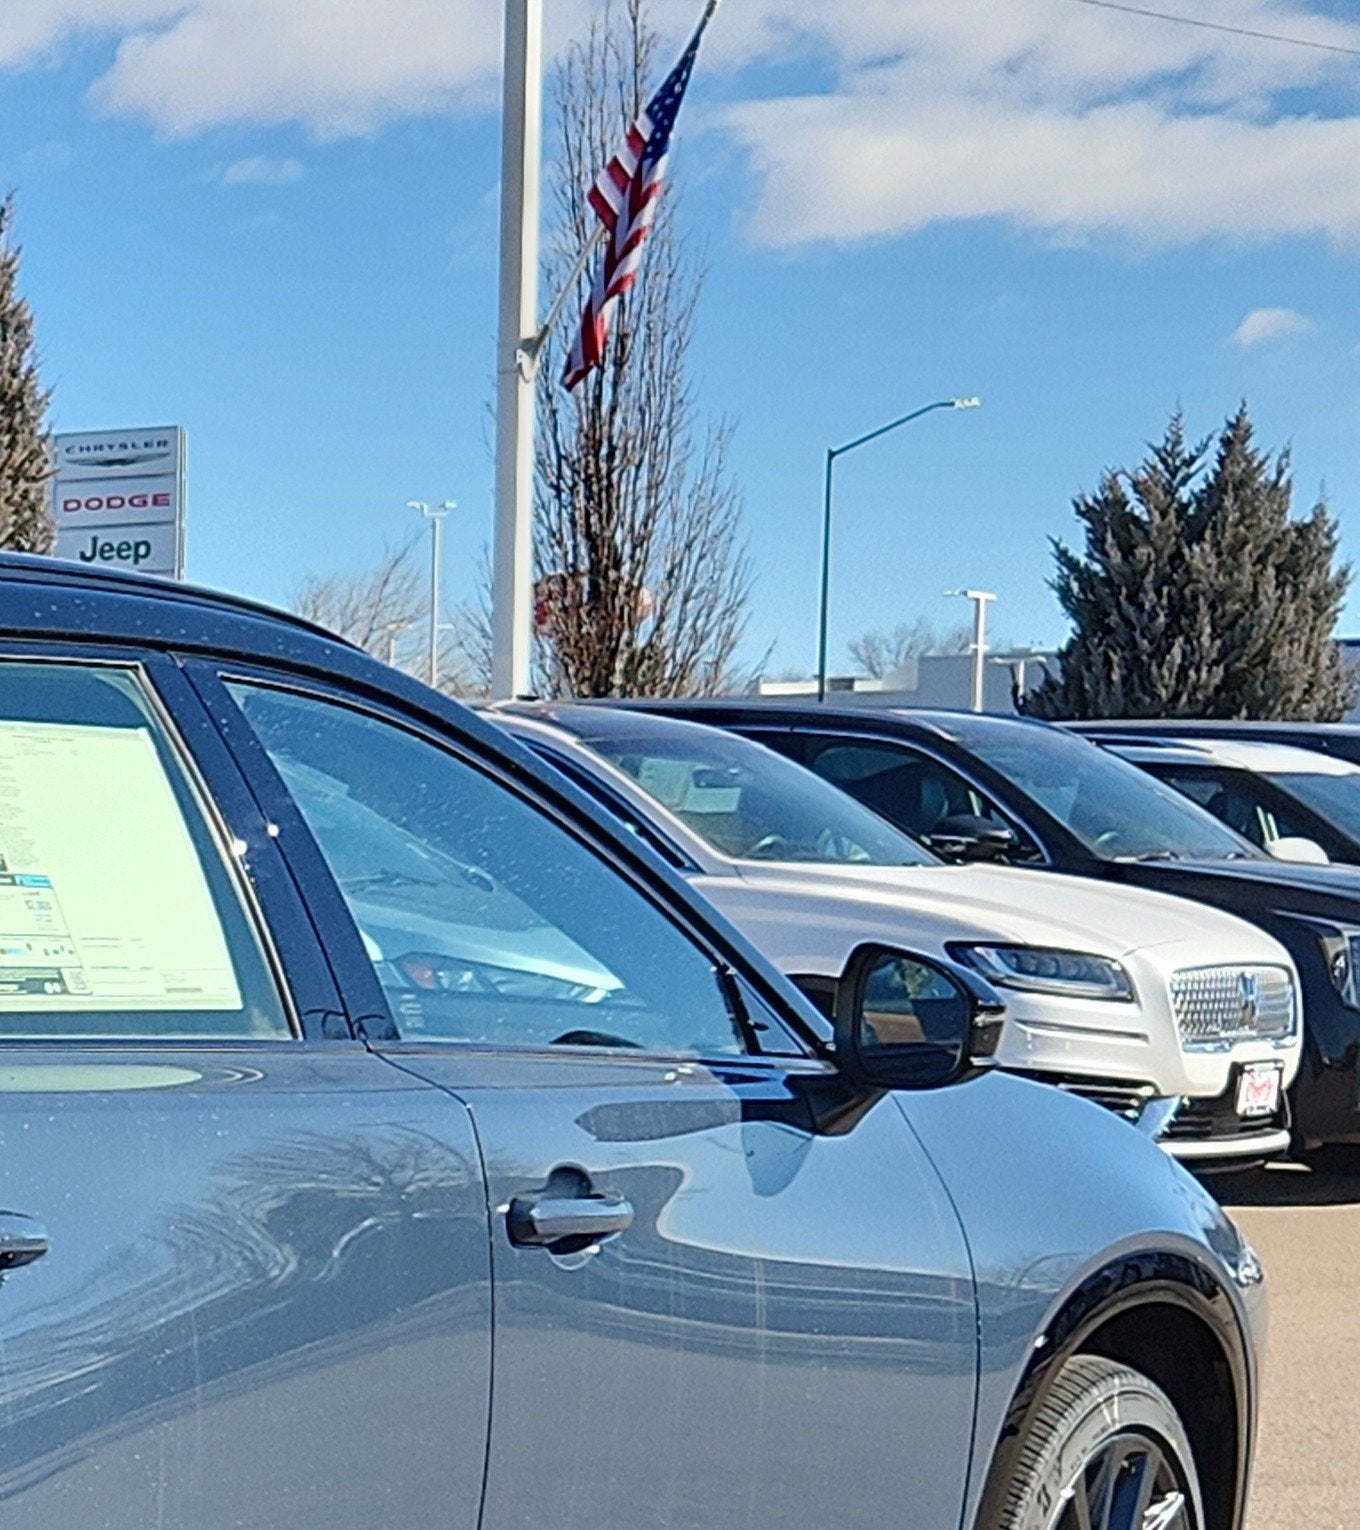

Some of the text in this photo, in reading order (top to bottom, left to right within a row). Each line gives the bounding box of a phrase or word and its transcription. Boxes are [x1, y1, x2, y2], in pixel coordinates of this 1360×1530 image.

[65, 439, 169, 455] CHRYSLER
[62, 493, 171, 513] DODGE
[79, 535, 152, 565] Jeep
